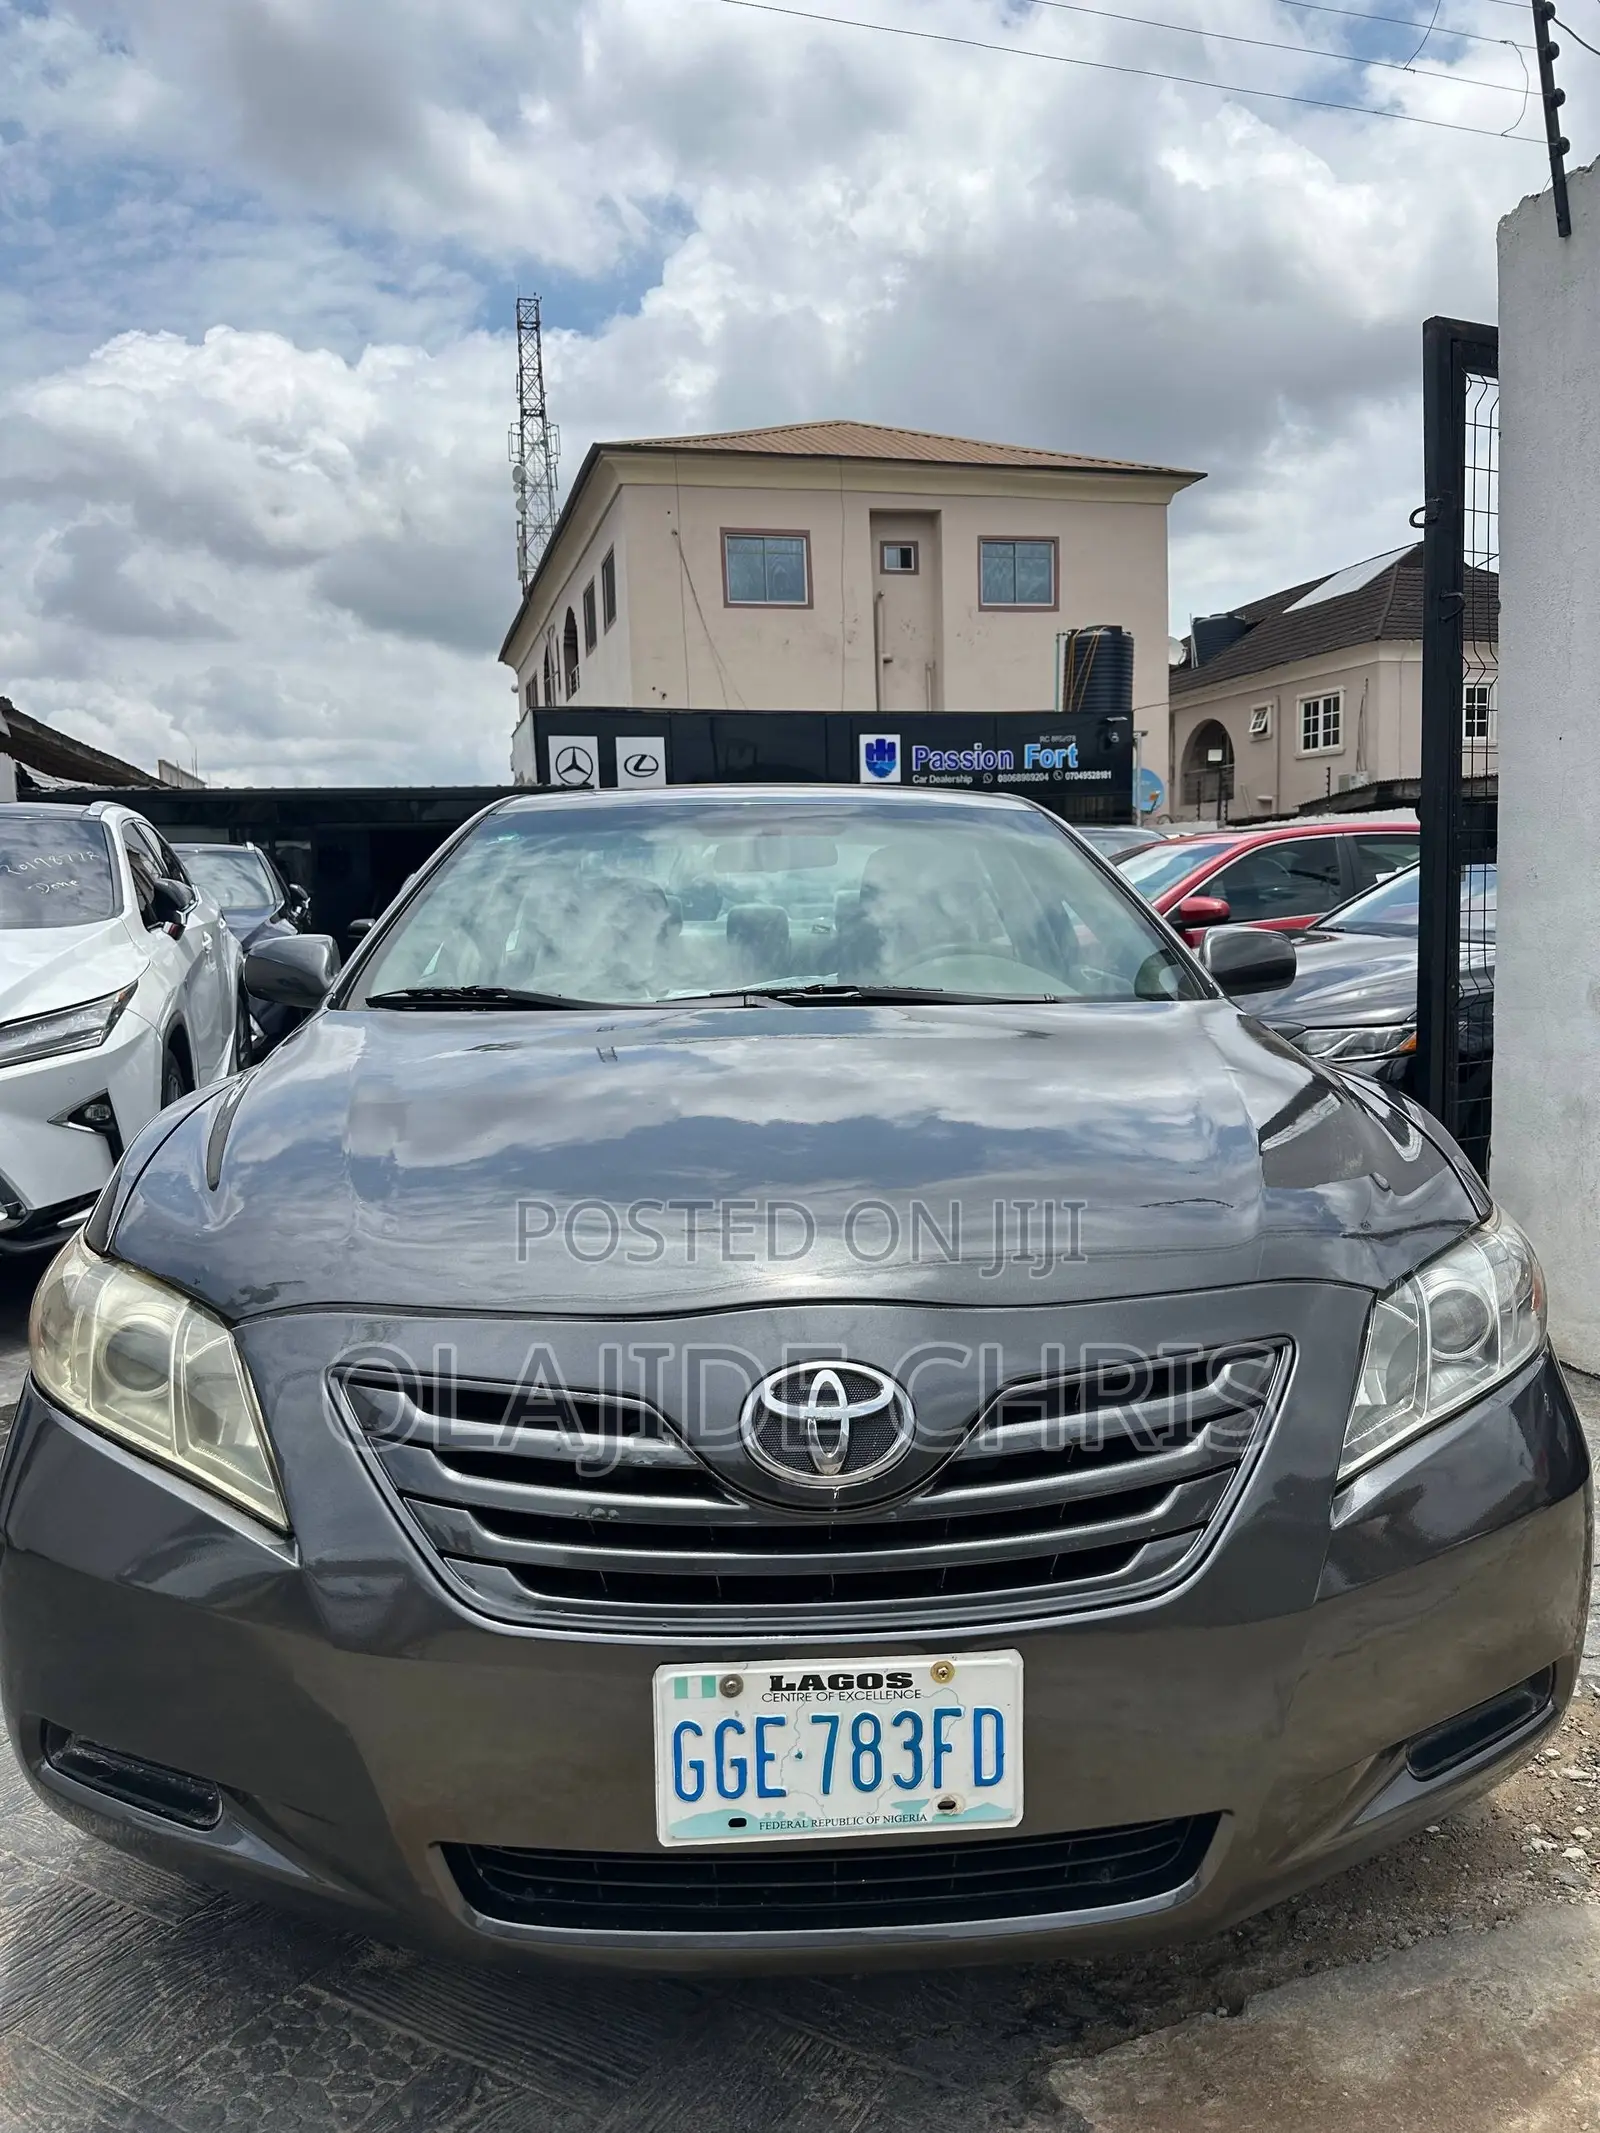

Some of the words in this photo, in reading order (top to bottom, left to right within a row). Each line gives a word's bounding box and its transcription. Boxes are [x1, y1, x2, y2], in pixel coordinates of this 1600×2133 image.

[912, 743, 1014, 771] Passion
[1023, 743, 1079, 770] Fort
[912, 774, 928, 784] Car
[929, 774, 973, 785] Dealership
[769, 1672, 914, 1691] LAGOS
[762, 1691, 812, 1703] CENTRE
[816, 1691, 835, 1702] OF
[838, 1689, 922, 1701] EXCELLENCE
[759, 1820, 808, 1831] FEDERAL
[811, 1816, 864, 1828] REPUBLIC
[866, 1815, 881, 1825] OF
[882, 1813, 928, 1824] NIGERIA
